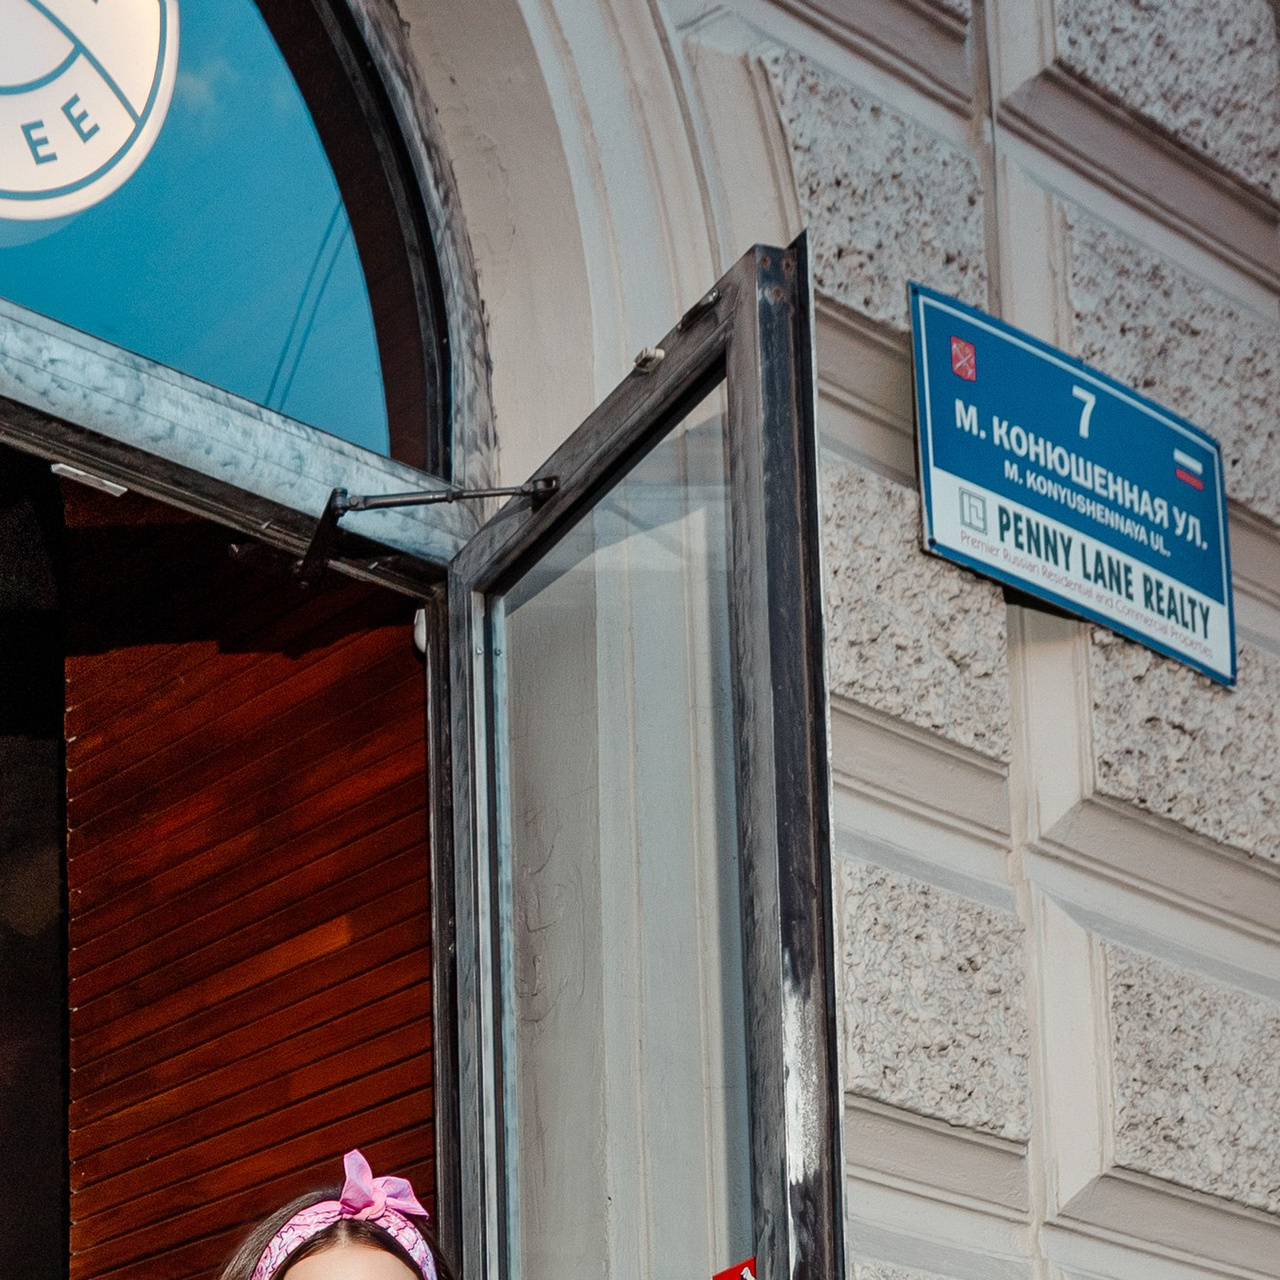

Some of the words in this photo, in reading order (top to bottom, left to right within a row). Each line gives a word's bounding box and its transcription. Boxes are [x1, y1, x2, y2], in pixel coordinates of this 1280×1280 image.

[1072, 385, 1096, 439] 7
[955, 398, 986, 440] М.
[992, 415, 1169, 529] КОНЮШЕННАЯ
[1172, 505, 1208, 550] УЛ.
[1004, 459, 1023, 485] M.
[1026, 469, 1147, 546] KONYUSHENNAYA
[1150, 530, 1171, 557] UL.
[997, 504, 1072, 572] PENNY
[1081, 542, 1134, 601] LANE
[1143, 572, 1211, 640] REALTY
